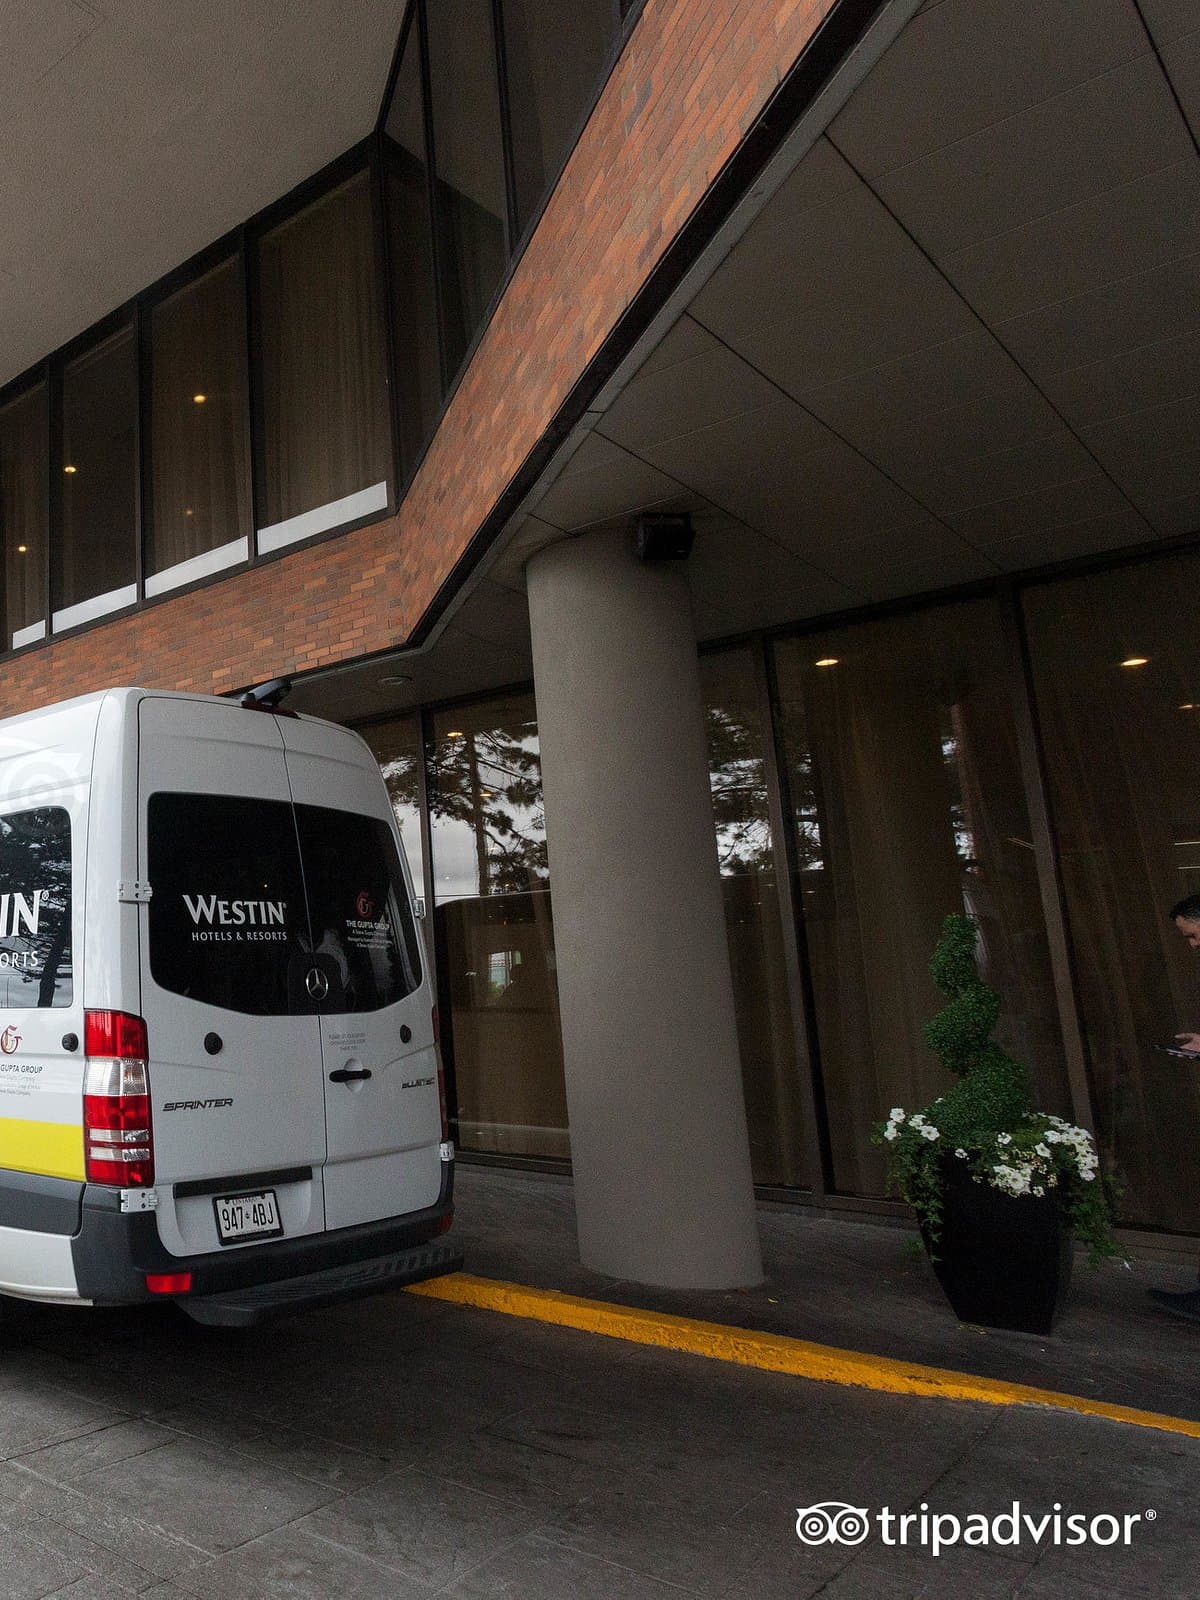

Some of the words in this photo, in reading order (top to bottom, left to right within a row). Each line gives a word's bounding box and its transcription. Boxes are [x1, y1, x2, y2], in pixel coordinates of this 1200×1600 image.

[191, 931, 233, 941] HOTELS
[236, 931, 244, 941] &
[246, 931, 288, 941] RESORTS
[0, 1063, 20, 1073] GUPTA
[20, 1064, 43, 1074] GROUP
[163, 1098, 234, 1112] SPRINTER
